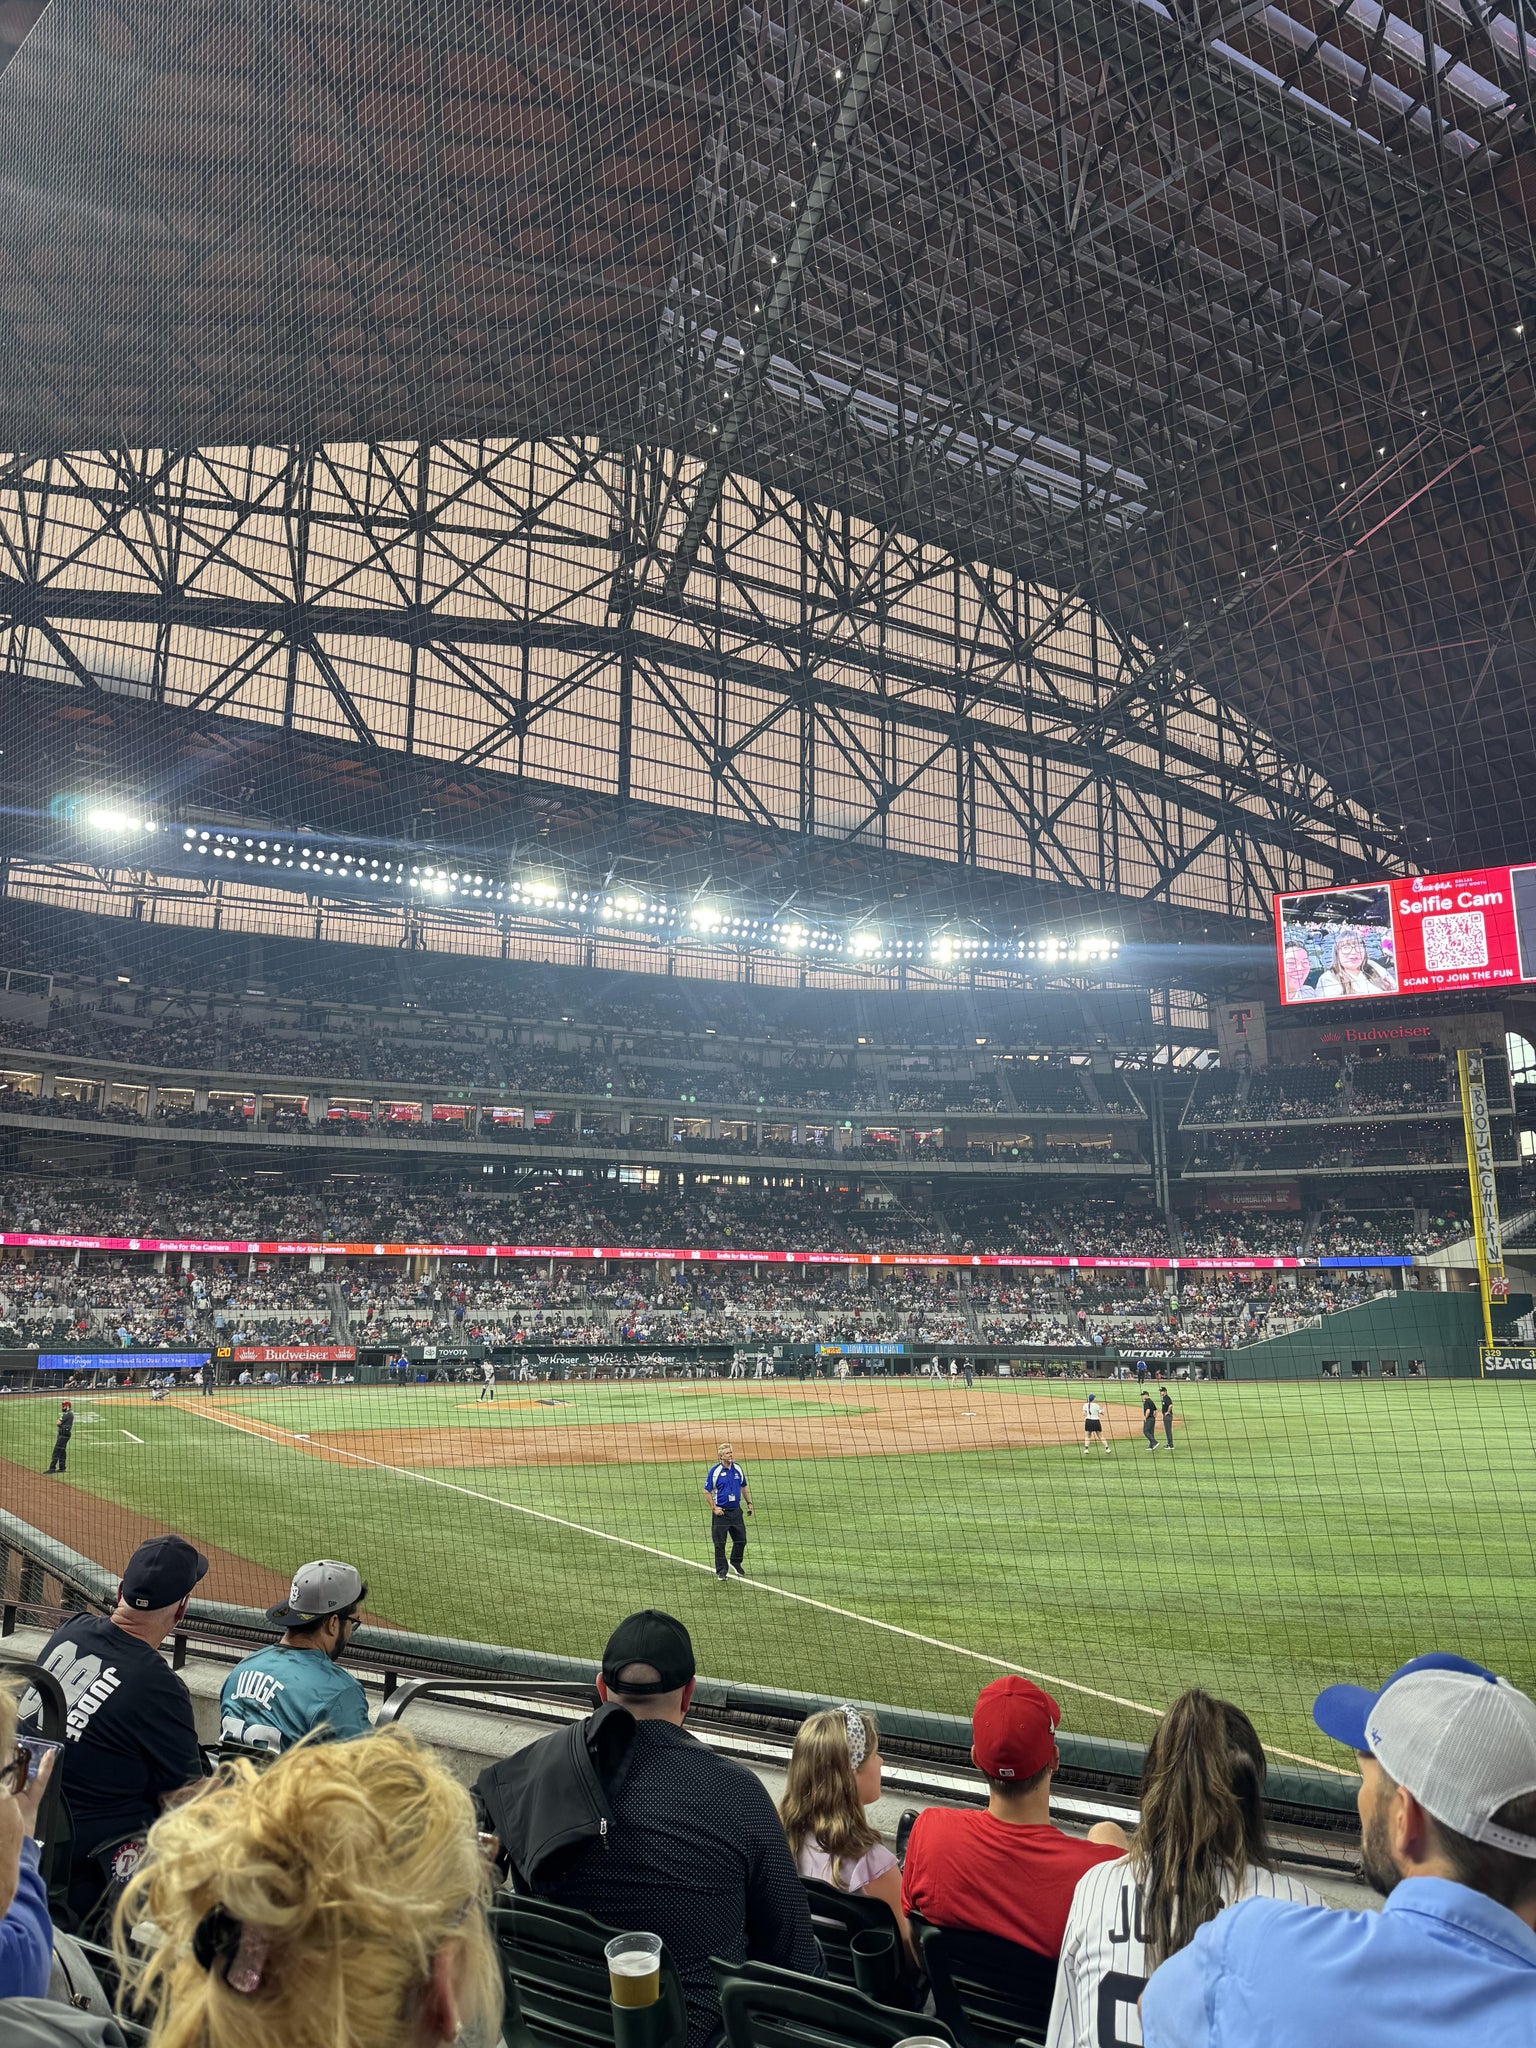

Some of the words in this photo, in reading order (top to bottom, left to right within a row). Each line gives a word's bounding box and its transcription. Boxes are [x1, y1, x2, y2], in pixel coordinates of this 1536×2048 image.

[1400, 895, 1452, 915] Selfie
[1457, 892, 1503, 908] Cam
[1403, 977, 1428, 986] SCAN
[1431, 975, 1444, 984] TO
[1446, 972, 1470, 982] JOIN
[1472, 970, 1491, 980] THE
[1494, 968, 1513, 978] FUN
[1229, 1009, 1252, 1036] T
[1345, 1026, 1430, 1042] Budweiser
[28, 1238, 47, 1246] Smile
[48, 1238, 59, 1246] for
[60, 1238, 72, 1246] the
[72, 1239, 100, 1248] Camera
[202, 1244, 229, 1252] Camera
[620, 1250, 634, 1258] Smile
[895, 1256, 910, 1264] Smile
[216, 1347, 231, 1357] 120
[265, 1349, 328, 1360] Budweiser
[848, 1344, 862, 1354] HOW
[865, 1344, 872, 1354] TO
[1118, 1350, 1172, 1358] VICTORY
[550, 1353, 579, 1364] Kroger
[231, 1671, 285, 1711] JUDGE
[66, 1667, 121, 1742] JUDGE
